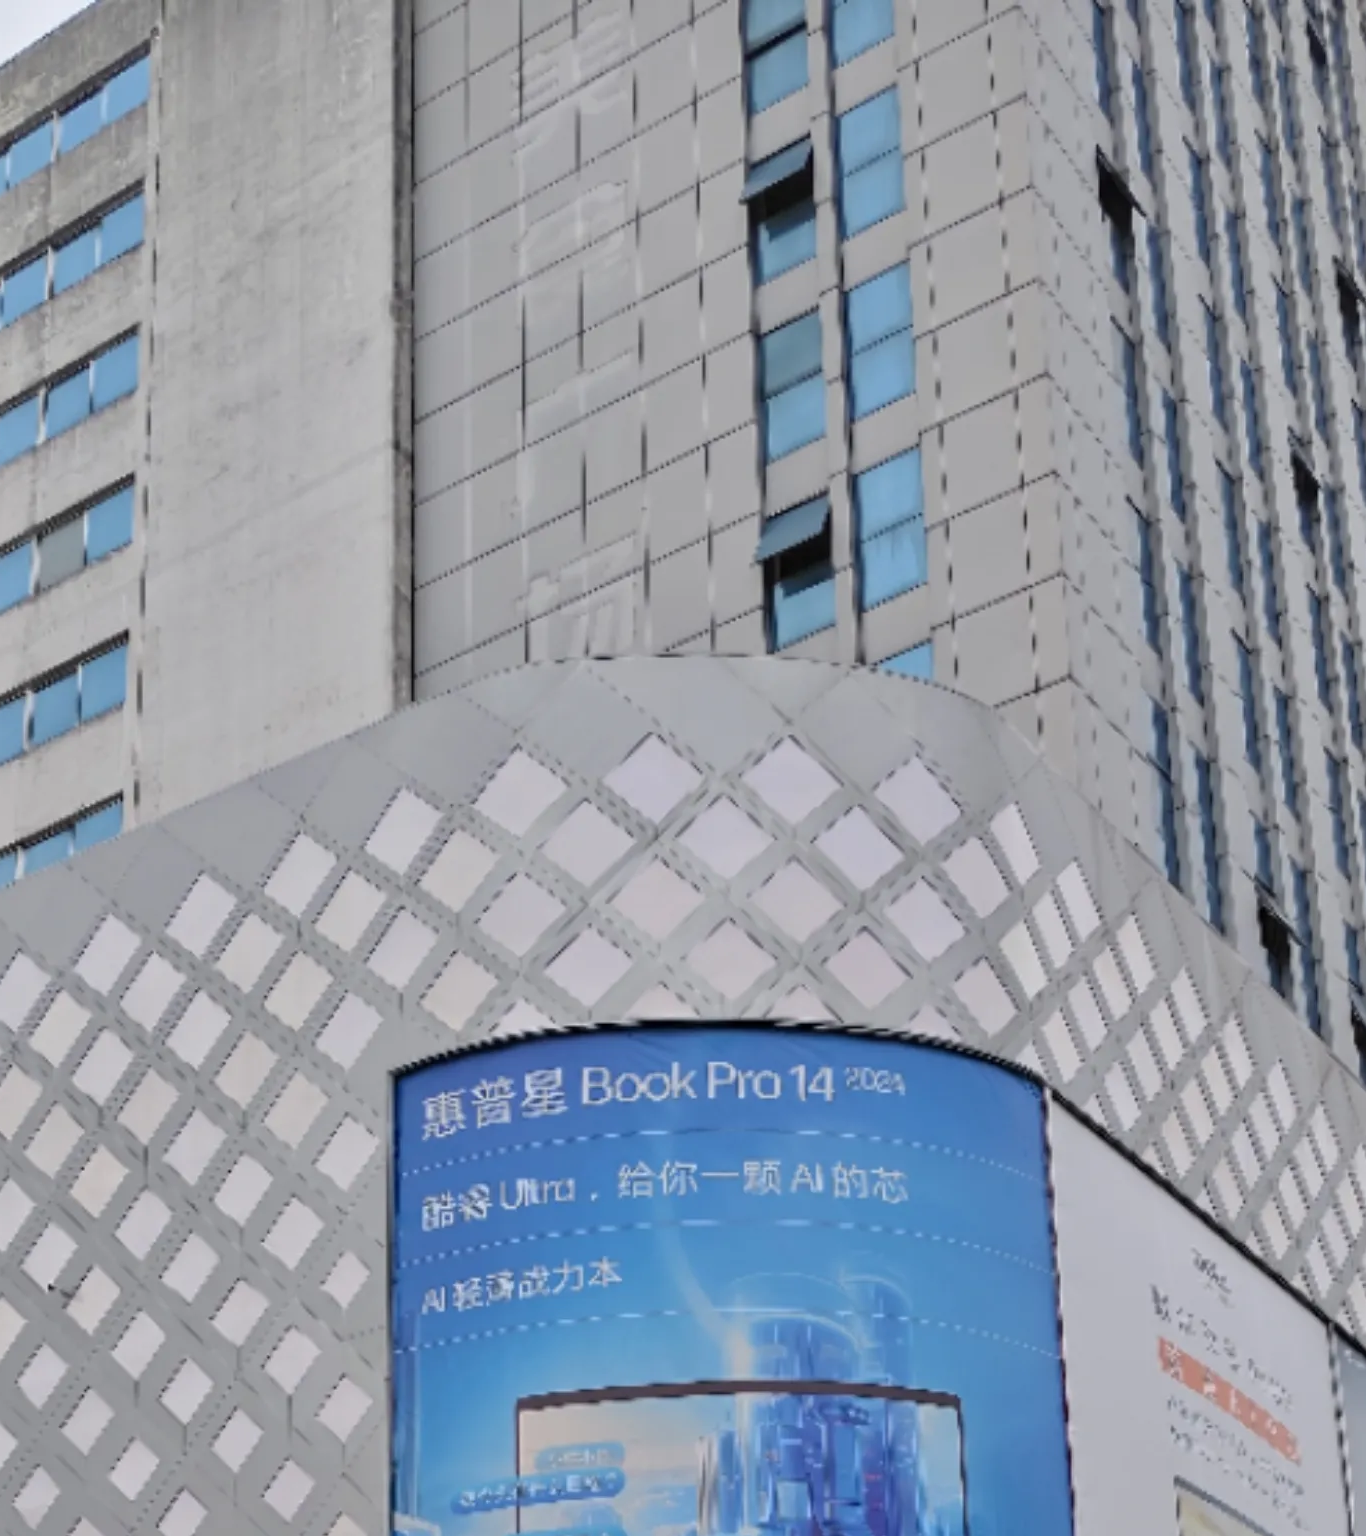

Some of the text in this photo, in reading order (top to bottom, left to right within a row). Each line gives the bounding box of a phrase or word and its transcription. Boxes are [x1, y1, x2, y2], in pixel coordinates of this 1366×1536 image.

[422, 1066, 568, 1142] 惠普星
[582, 1061, 696, 1105] Book
[707, 1061, 782, 1101] Pro
[789, 1064, 835, 1102] 14
